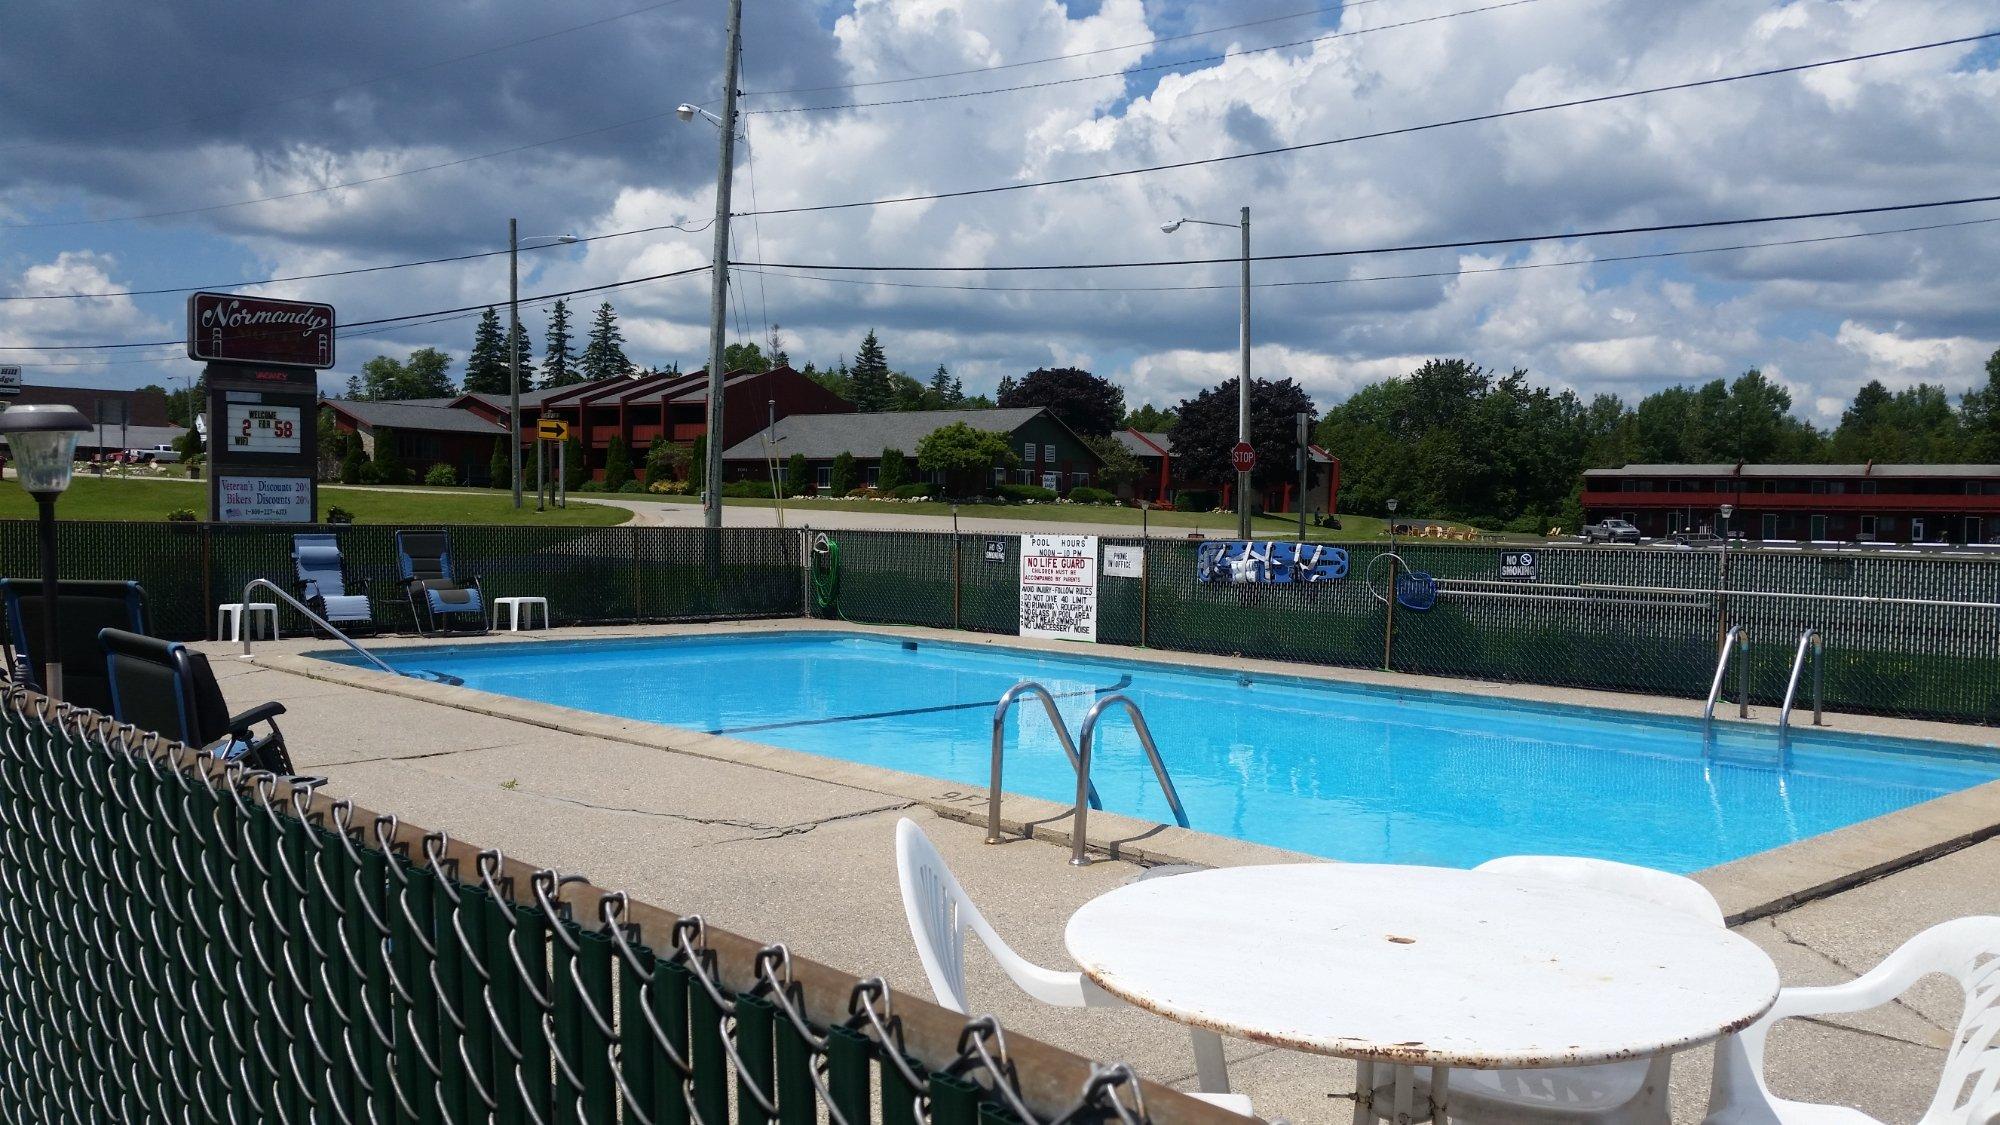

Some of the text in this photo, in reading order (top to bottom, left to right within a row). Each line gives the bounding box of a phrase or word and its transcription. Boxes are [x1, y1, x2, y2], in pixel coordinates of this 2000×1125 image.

[202, 300, 327, 337] Normandy
[249, 410, 277, 419] WELCOME
[243, 419, 251, 437] 2
[275, 420, 293, 438] 58
[1234, 451, 1253, 463] STOP
[221, 480, 253, 491] Veteran's
[258, 480, 292, 492] Discounts
[227, 493, 252, 504] Bikers
[256, 493, 291, 504] Discounts
[1061, 539, 1086, 547] HOURS
[1027, 558, 1085, 569] NO LIFE GUARD
[1506, 555, 1517, 565] NO
[1501, 565, 1535, 575] SMOKING
[1076, 587, 1093, 596] RULES
[1032, 602, 1054, 610] RUNNING
[1060, 604, 1093, 612] ROUGHPLAY
[1032, 609, 1050, 617] GLASS
[1074, 624, 1090, 634] NOISE
